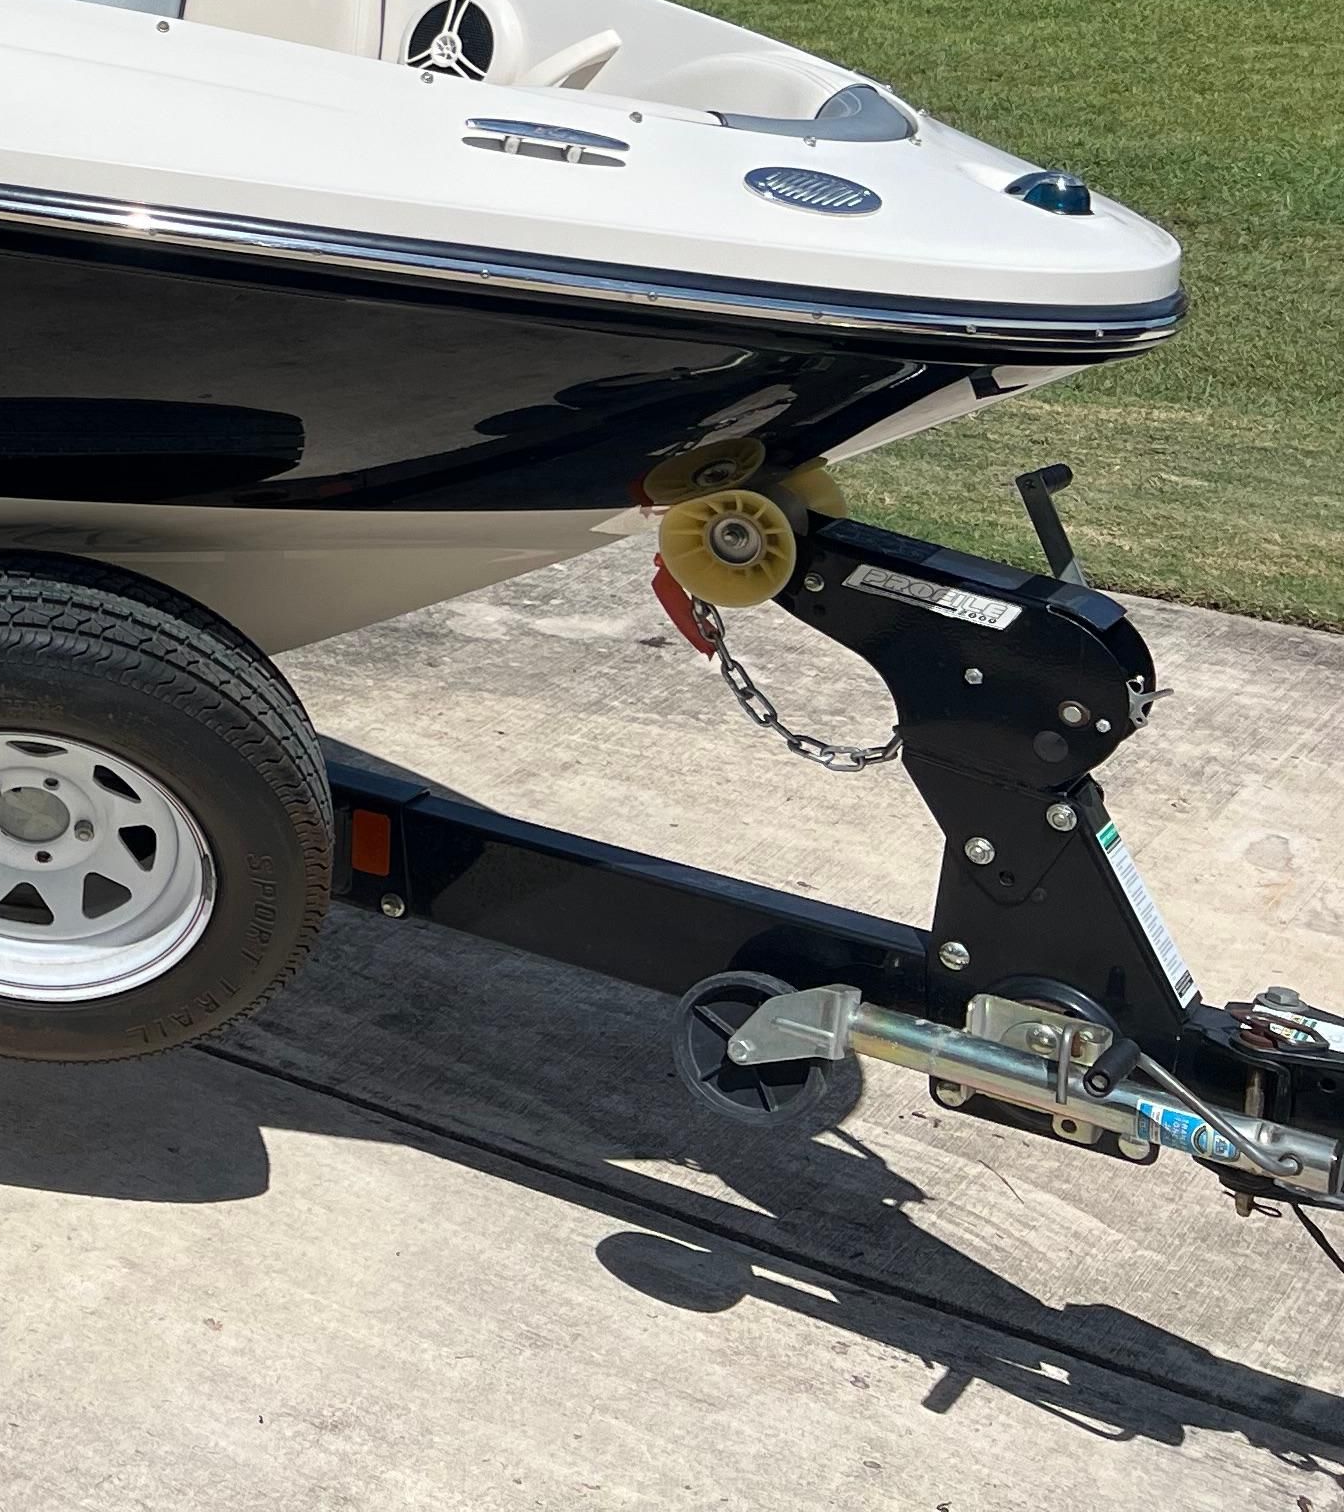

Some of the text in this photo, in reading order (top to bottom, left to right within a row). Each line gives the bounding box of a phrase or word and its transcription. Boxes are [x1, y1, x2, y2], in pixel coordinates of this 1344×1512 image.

[863, 569, 1009, 619] PROFILE
[127, 853, 278, 1043] SPORT TRAIL
